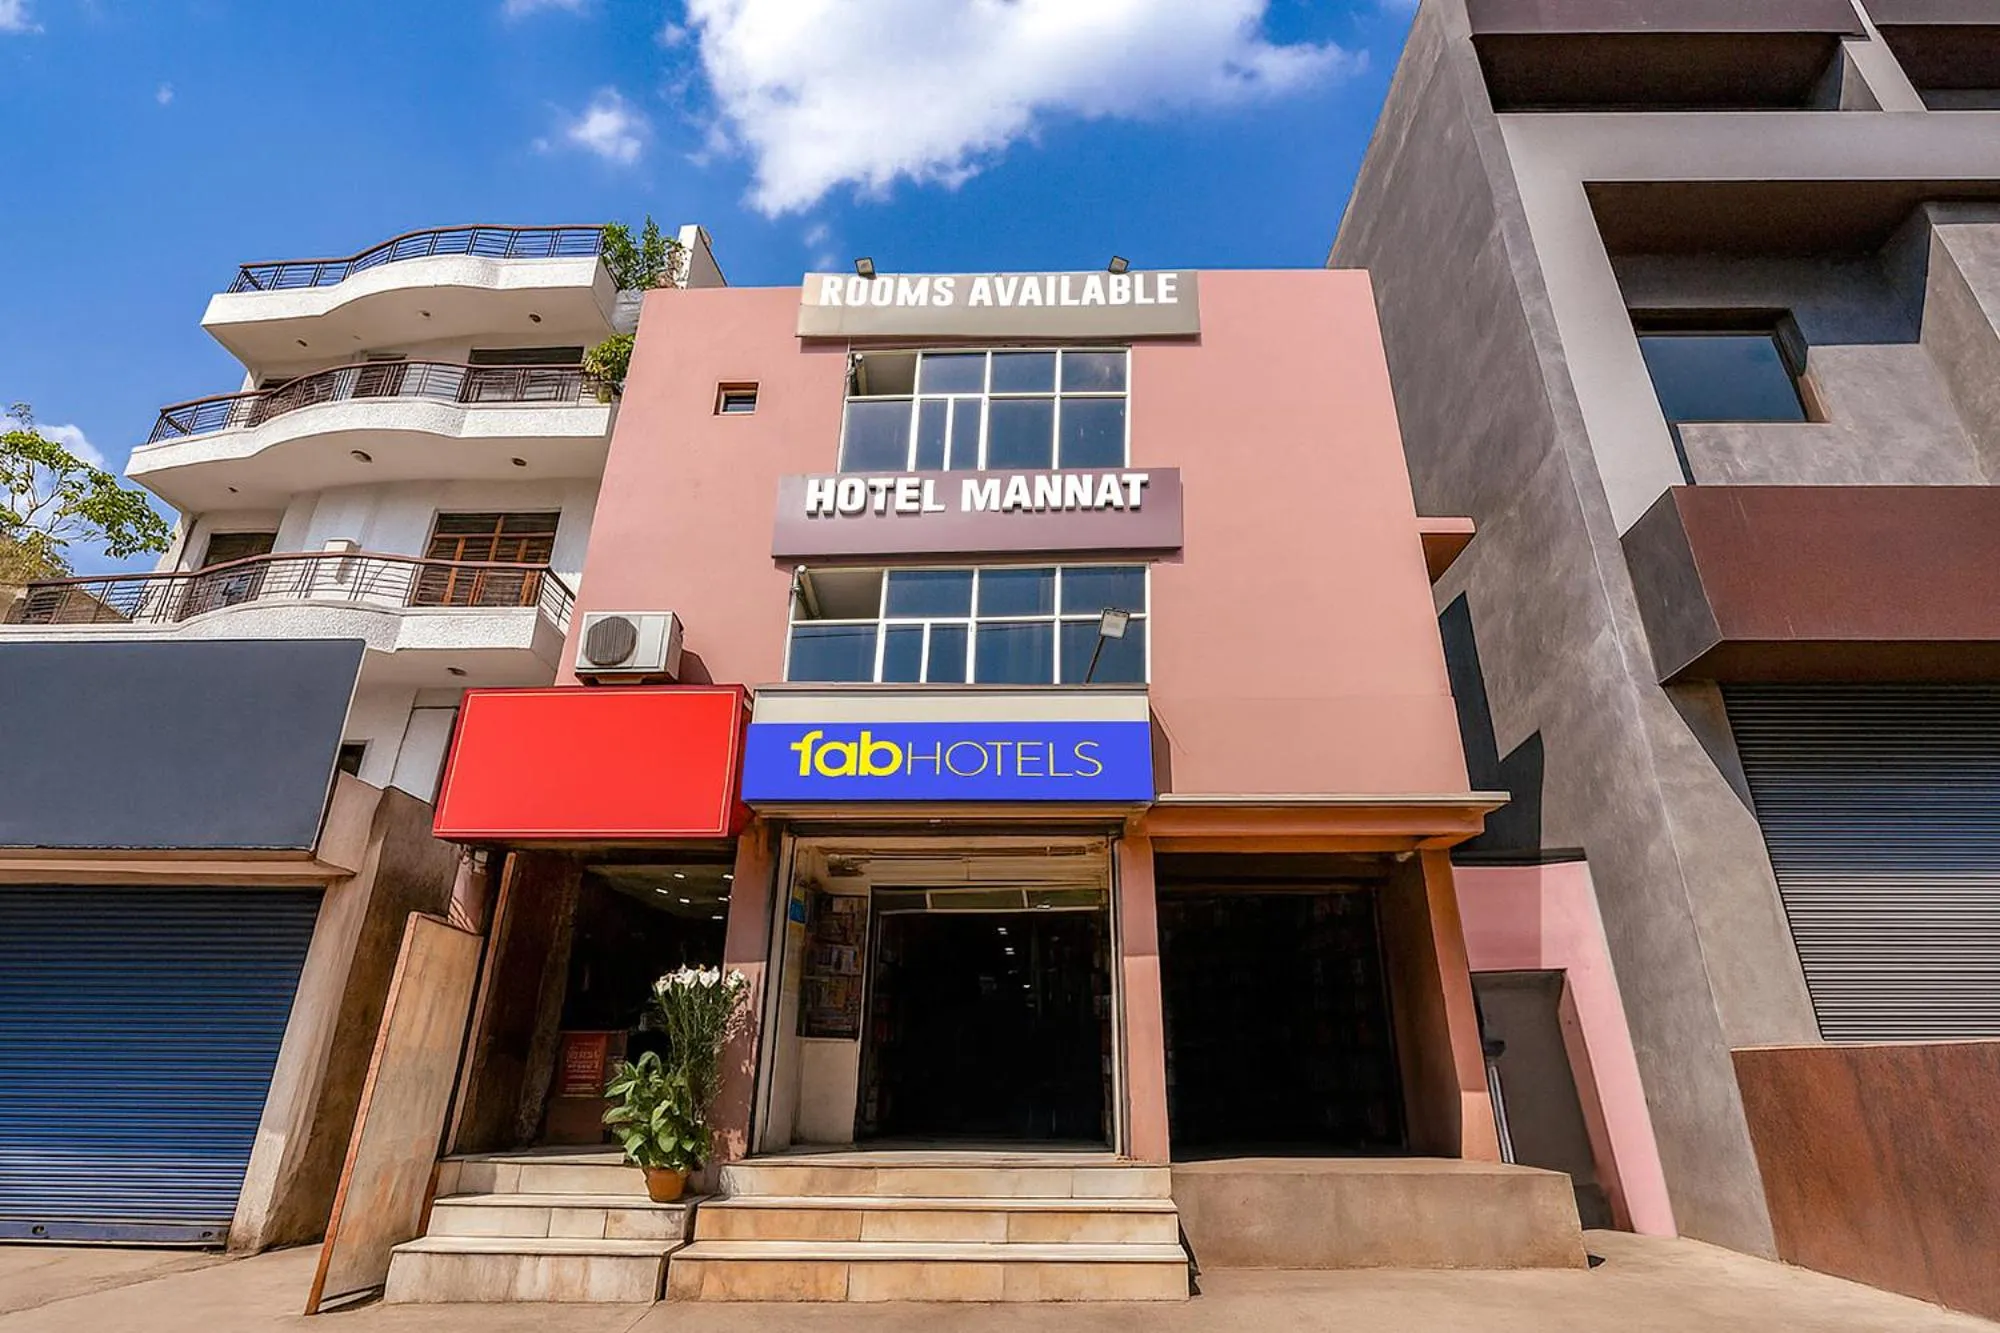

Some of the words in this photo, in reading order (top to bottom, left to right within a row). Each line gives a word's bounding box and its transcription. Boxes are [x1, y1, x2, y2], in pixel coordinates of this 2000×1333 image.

[819, 276, 956, 307] ROOMS
[968, 273, 1178, 307] AVAILABLE
[805, 477, 945, 514] HOTEL
[960, 473, 1149, 512] MANNAT
